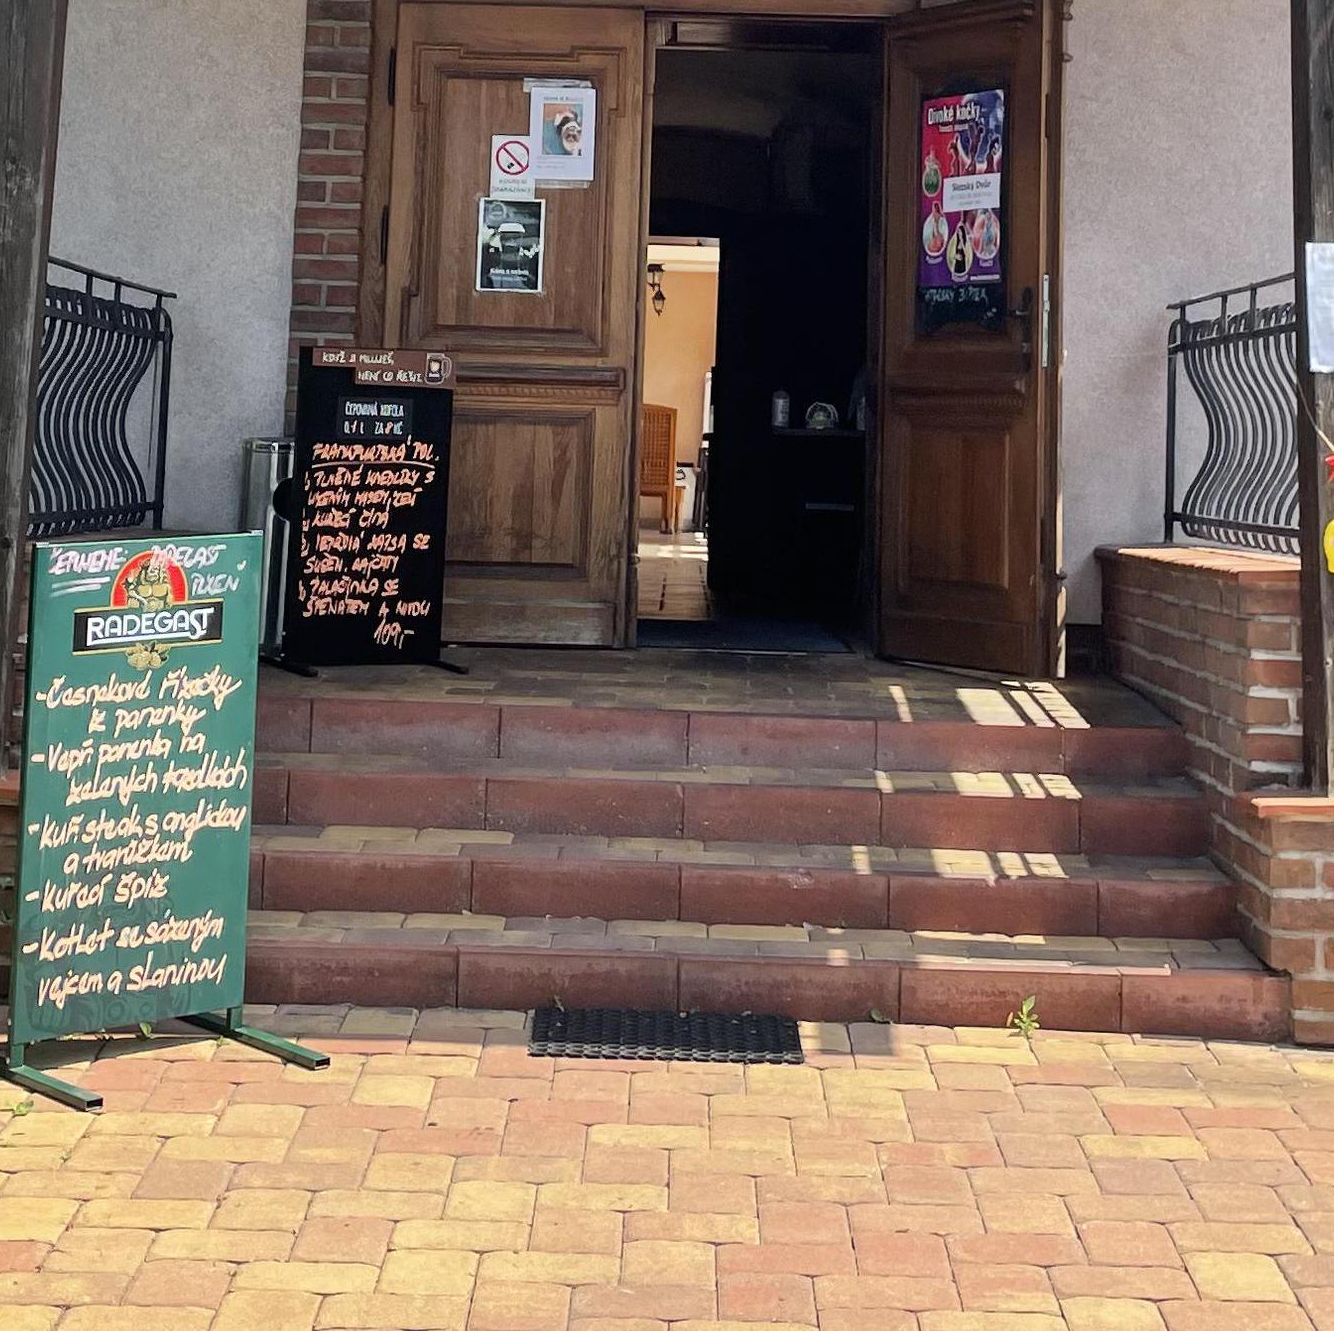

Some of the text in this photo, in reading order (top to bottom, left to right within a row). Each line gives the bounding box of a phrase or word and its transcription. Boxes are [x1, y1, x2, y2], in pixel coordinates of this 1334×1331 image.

[322, 350, 346, 364] KDYŽ
[380, 403, 404, 417] KOFOLA
[424, 470, 435, 484] S
[86, 607, 215, 646] RADEGAST
[179, 731, 206, 755] na
[82, 804, 143, 844] steak
[144, 813, 158, 836] s
[63, 853, 79, 875] a
[107, 970, 123, 995] a
